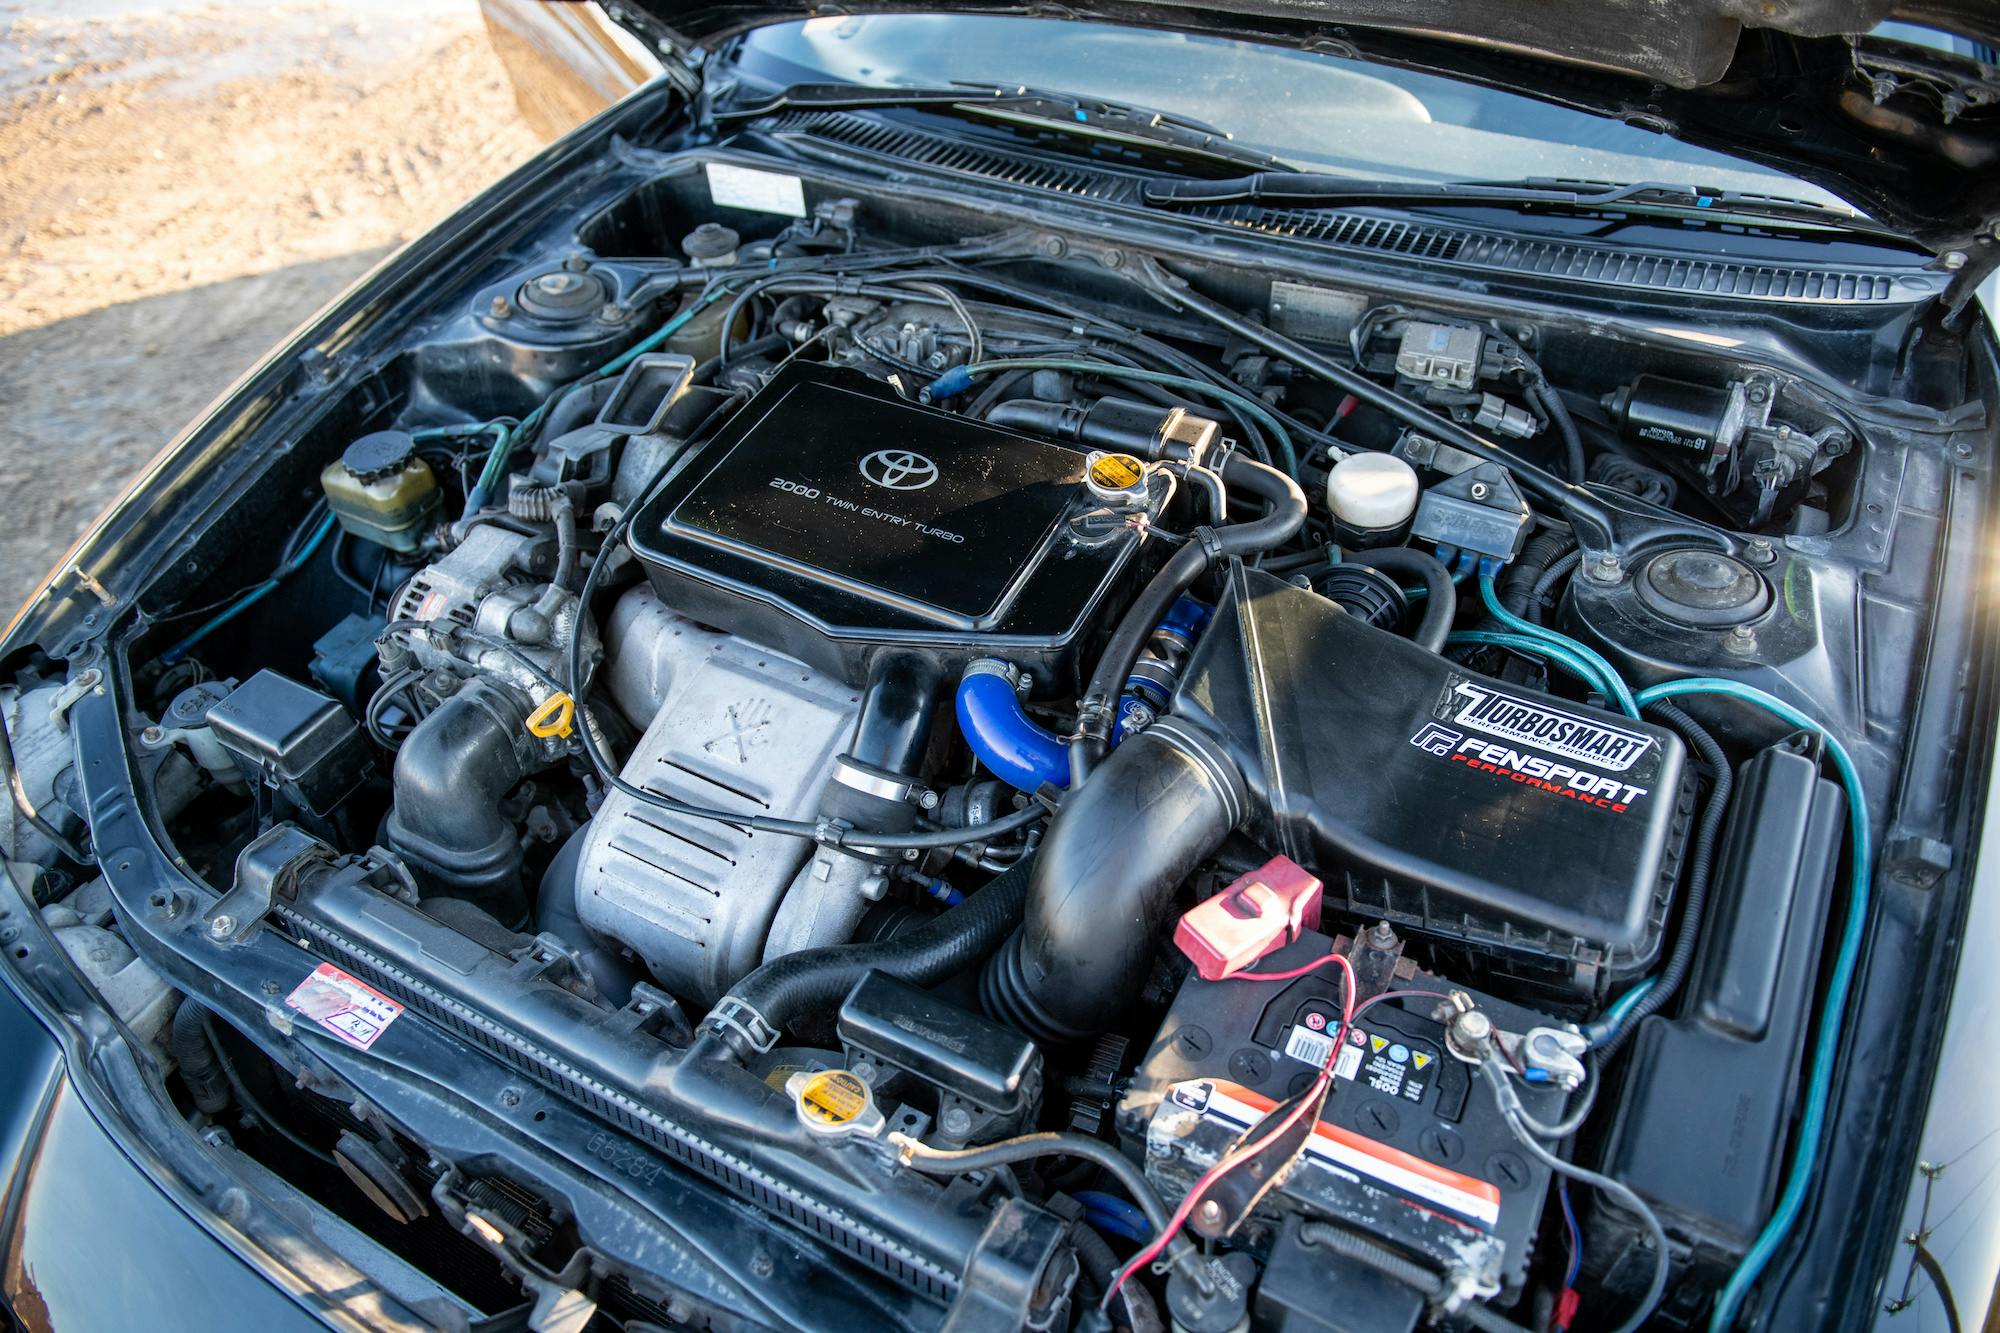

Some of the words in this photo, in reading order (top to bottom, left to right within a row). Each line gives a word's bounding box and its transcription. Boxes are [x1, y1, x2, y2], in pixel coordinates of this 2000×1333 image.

[769, 477, 821, 500] 2000
[825, 495, 860, 512] TWIN
[861, 507, 912, 528] ENTRY
[914, 522, 965, 544] TURBO
[1462, 716, 1553, 748] PERFORMANCE
[1557, 744, 1625, 769] PRODUCTS
[1463, 688, 1649, 764] TURBOSMART
[1450, 754, 1630, 814] PERFORMANCE
[1457, 738, 1648, 805] FENSPORT
